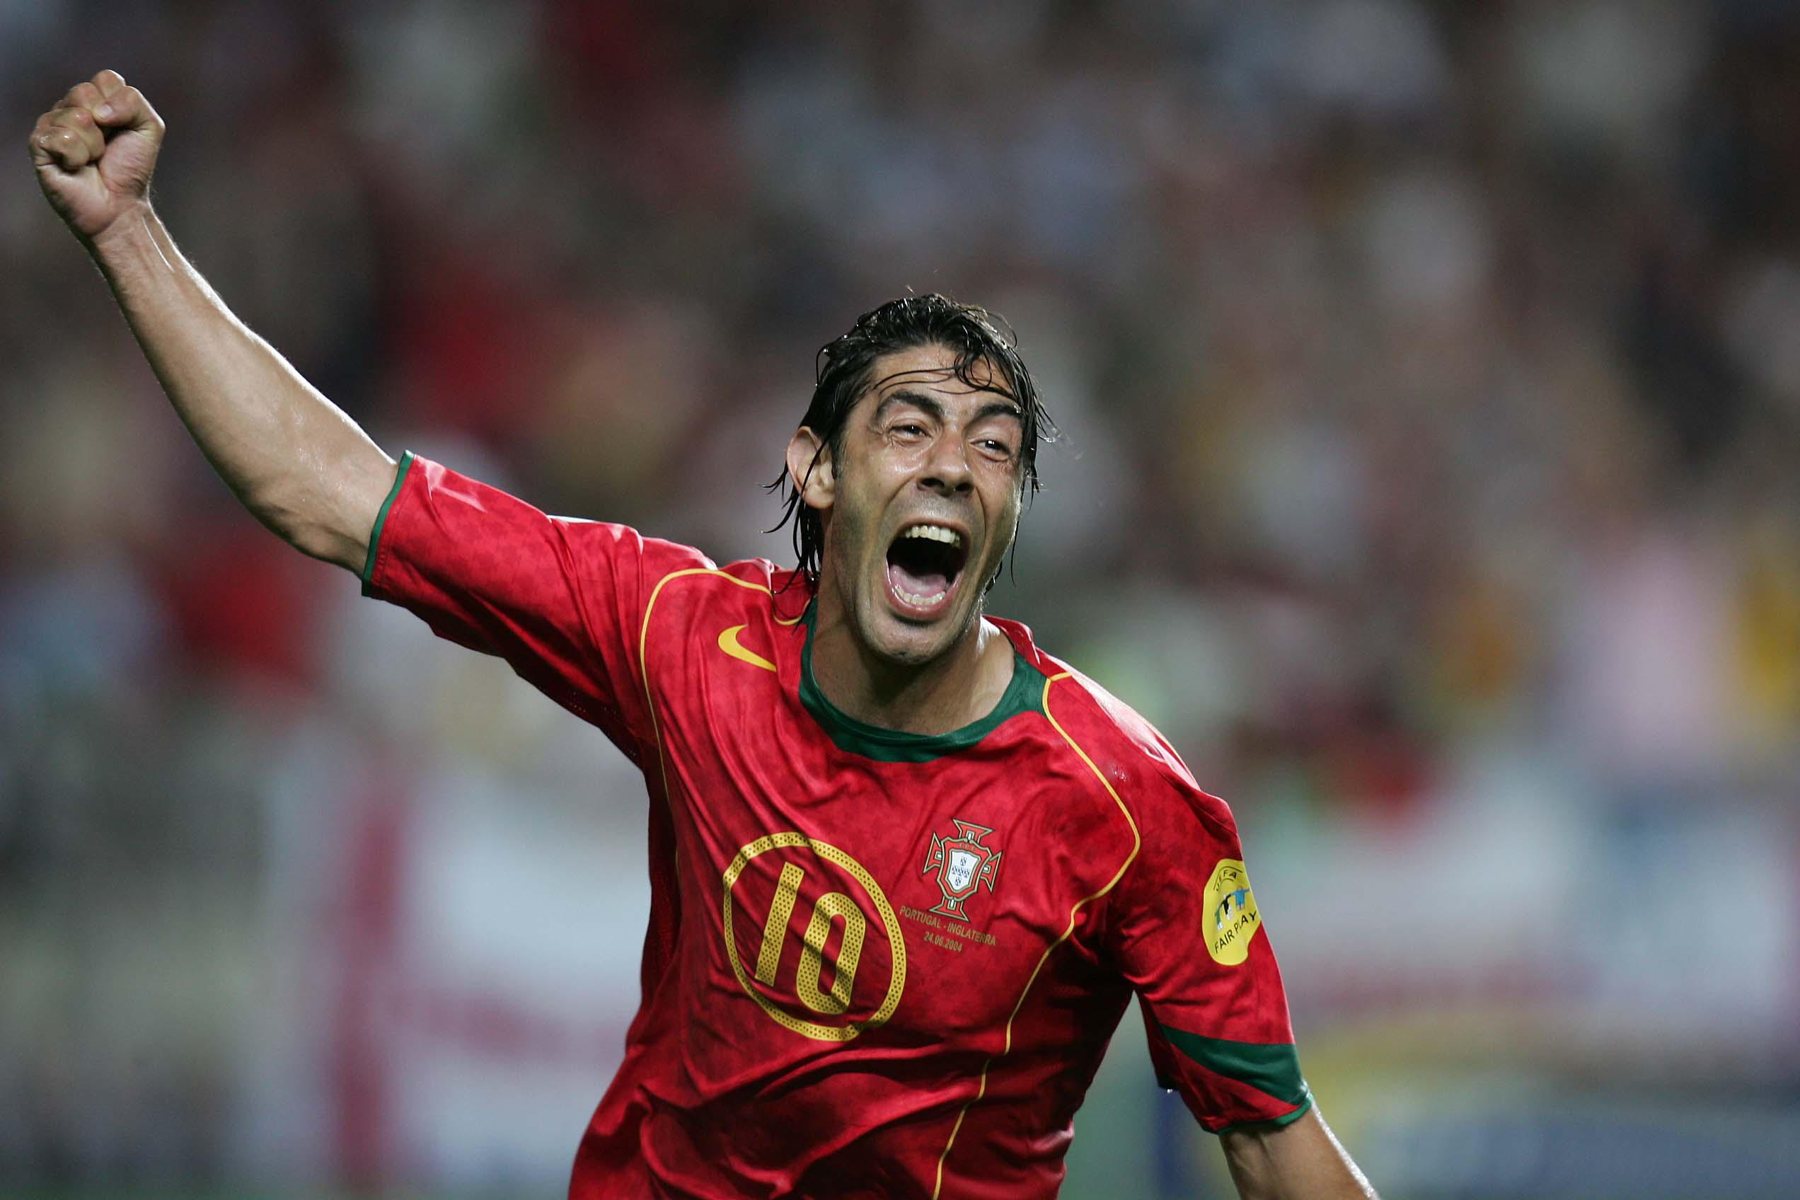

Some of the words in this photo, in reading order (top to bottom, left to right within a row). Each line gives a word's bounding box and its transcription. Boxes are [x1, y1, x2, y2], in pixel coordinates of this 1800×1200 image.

[755, 862, 866, 1014] 10
[900, 905, 941, 929] PORTUGAL
[947, 922, 997, 946] INGLATERRA
[923, 931, 964, 952] 24.06.2004
[1214, 929, 1235, 954] FAIR
[1234, 910, 1257, 934] PAY
